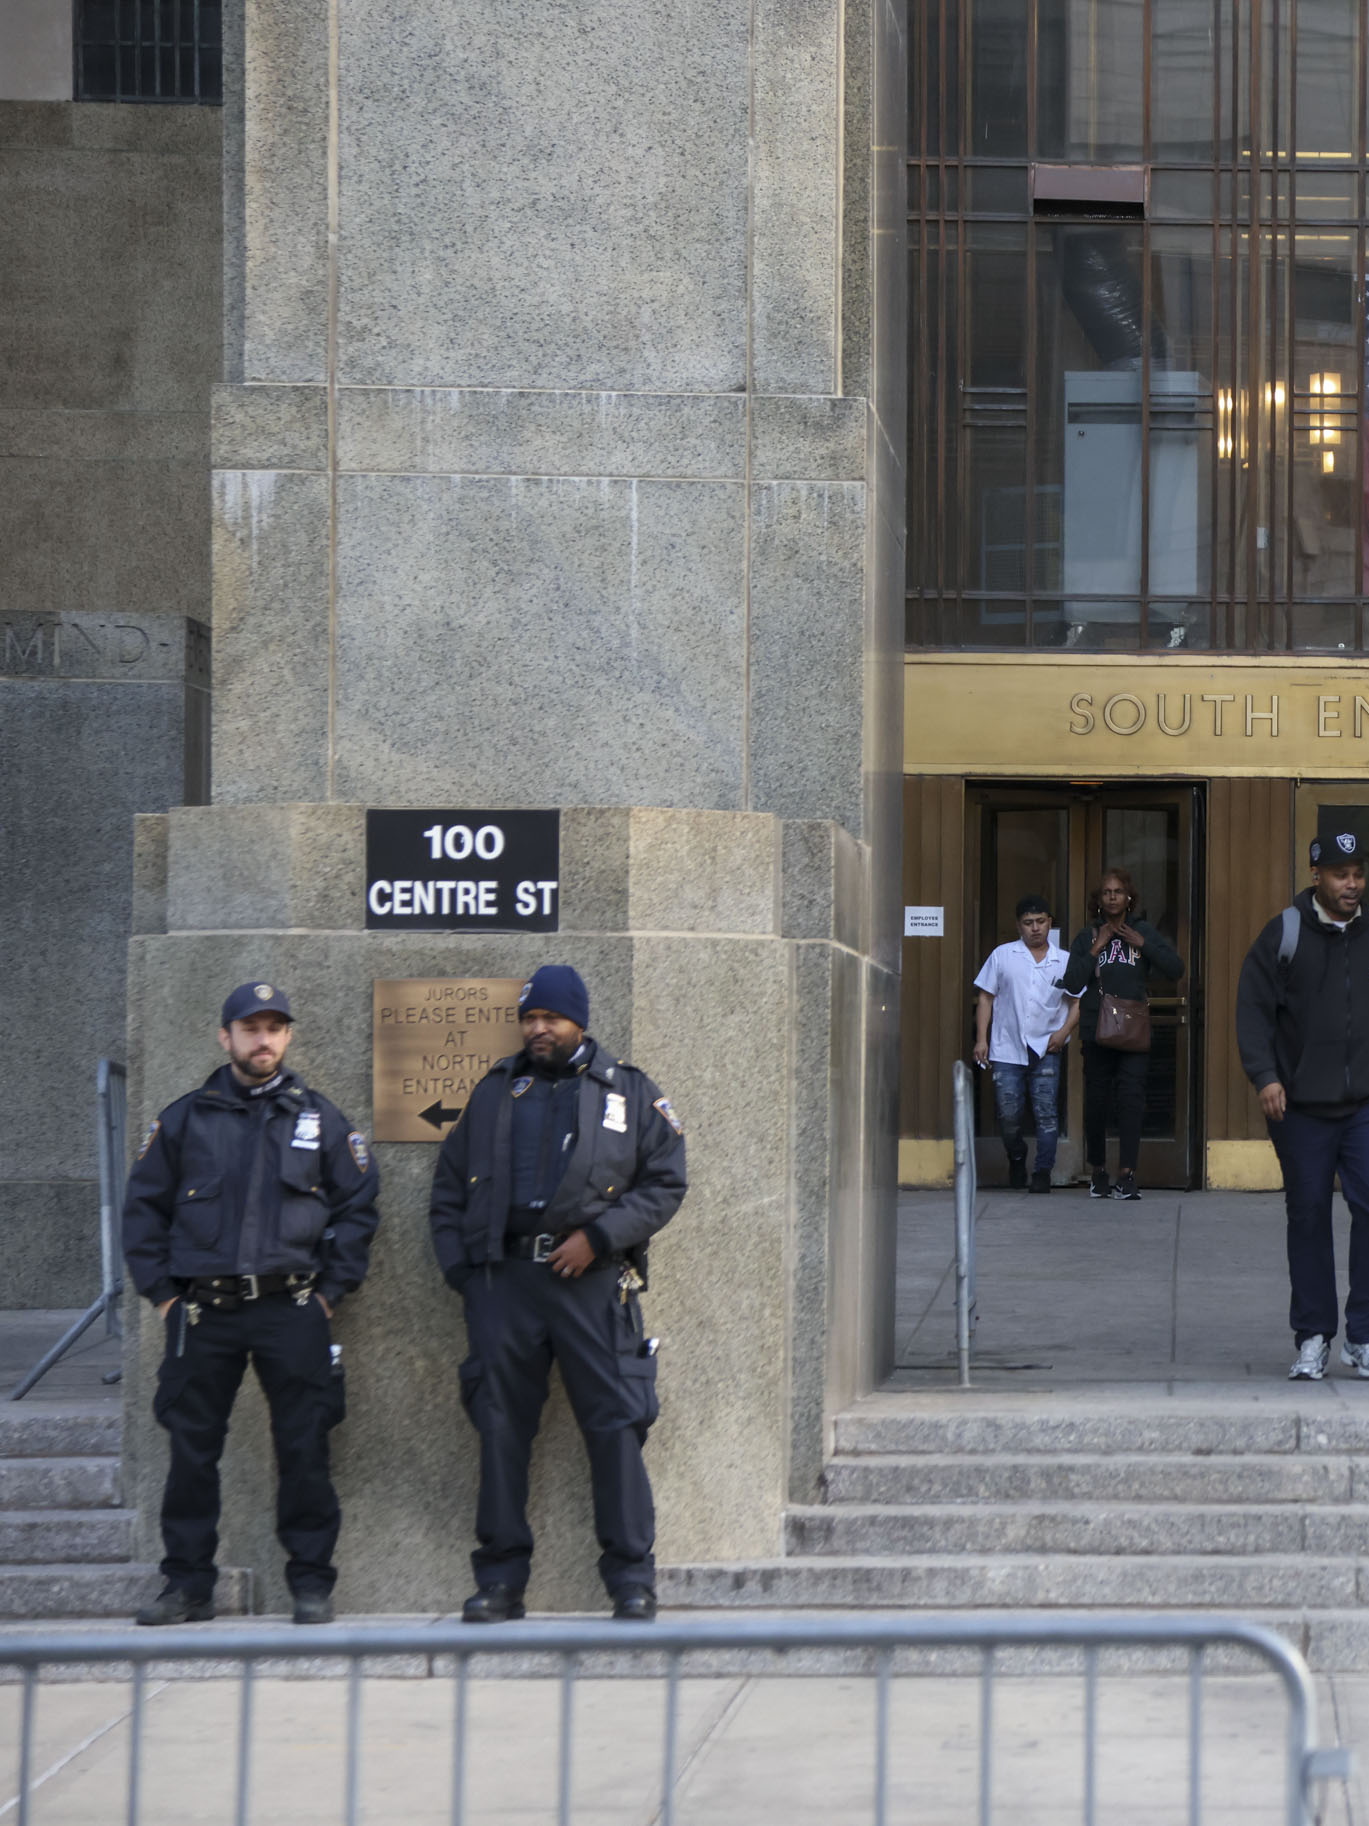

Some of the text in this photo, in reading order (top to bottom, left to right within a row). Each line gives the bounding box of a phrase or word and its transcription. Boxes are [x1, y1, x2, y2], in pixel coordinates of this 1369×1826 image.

[1069, 692, 1279, 738] SOUTH
[423, 824, 505, 860] 100
[368, 879, 559, 917] CENTRE ST
[424, 987, 489, 1001] JURORS
[380, 1006, 520, 1024] PLEASE ENTE
[444, 1030, 469, 1048] AT
[422, 1054, 490, 1071] NORTH
